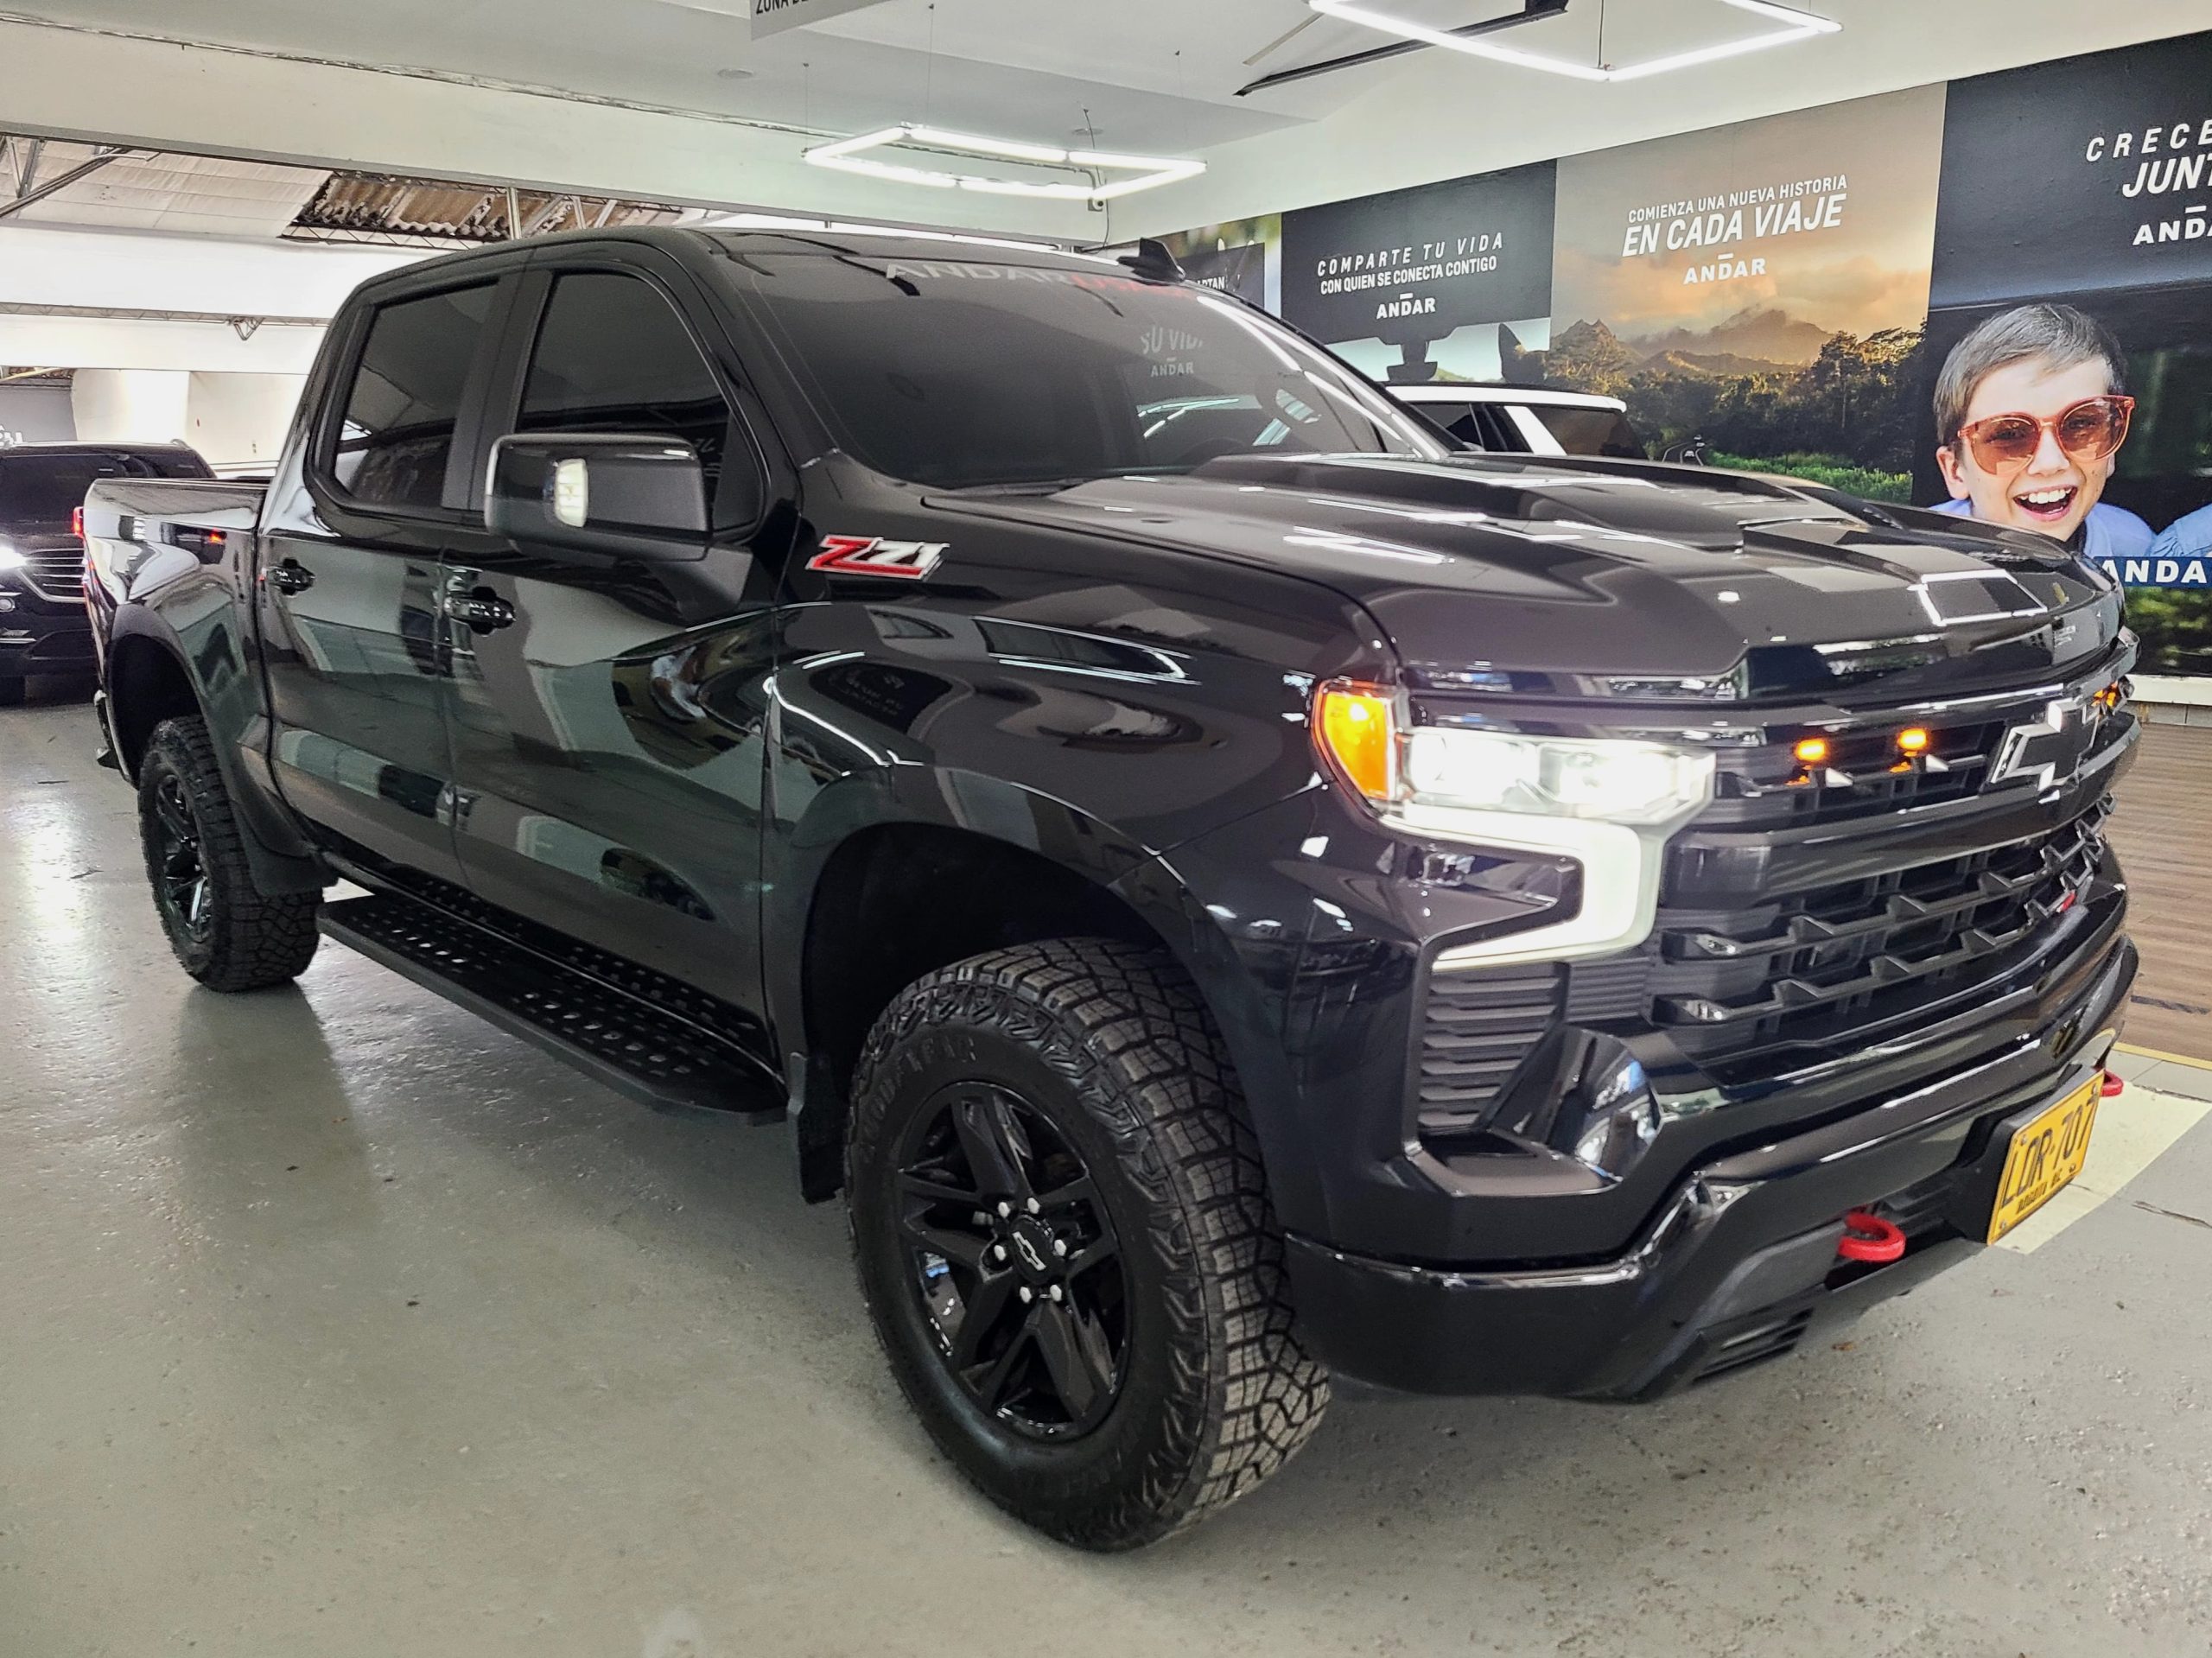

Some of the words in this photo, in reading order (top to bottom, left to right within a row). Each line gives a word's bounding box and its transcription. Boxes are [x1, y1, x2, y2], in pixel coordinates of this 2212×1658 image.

[1629, 200, 1694, 223] COMIENZA
[1698, 195, 1726, 213] UNA
[1729, 187, 1776, 206] NUEVA
[1779, 175, 1847, 199] HISTORIA
[1622, 223, 1661, 257] EN
[1666, 209, 1743, 251] CADA
[1755, 193, 1847, 238] VIAJE
[1318, 246, 1413, 276] COMPARTE
[1423, 241, 1446, 261] TU
[1457, 232, 1503, 256] VIDA
[1320, 278, 1342, 295] CON
[1344, 274, 1376, 292] QUIEN
[1377, 270, 1391, 287] SE
[1393, 262, 1444, 284] CONECTA
[1446, 255, 1497, 277] CONTIGO
[1683, 253, 1766, 285] ANDAR
[1376, 292, 1436, 320] ANDAR
[1151, 357, 1193, 378] ANDAR
[804, 533, 950, 581] Z71
